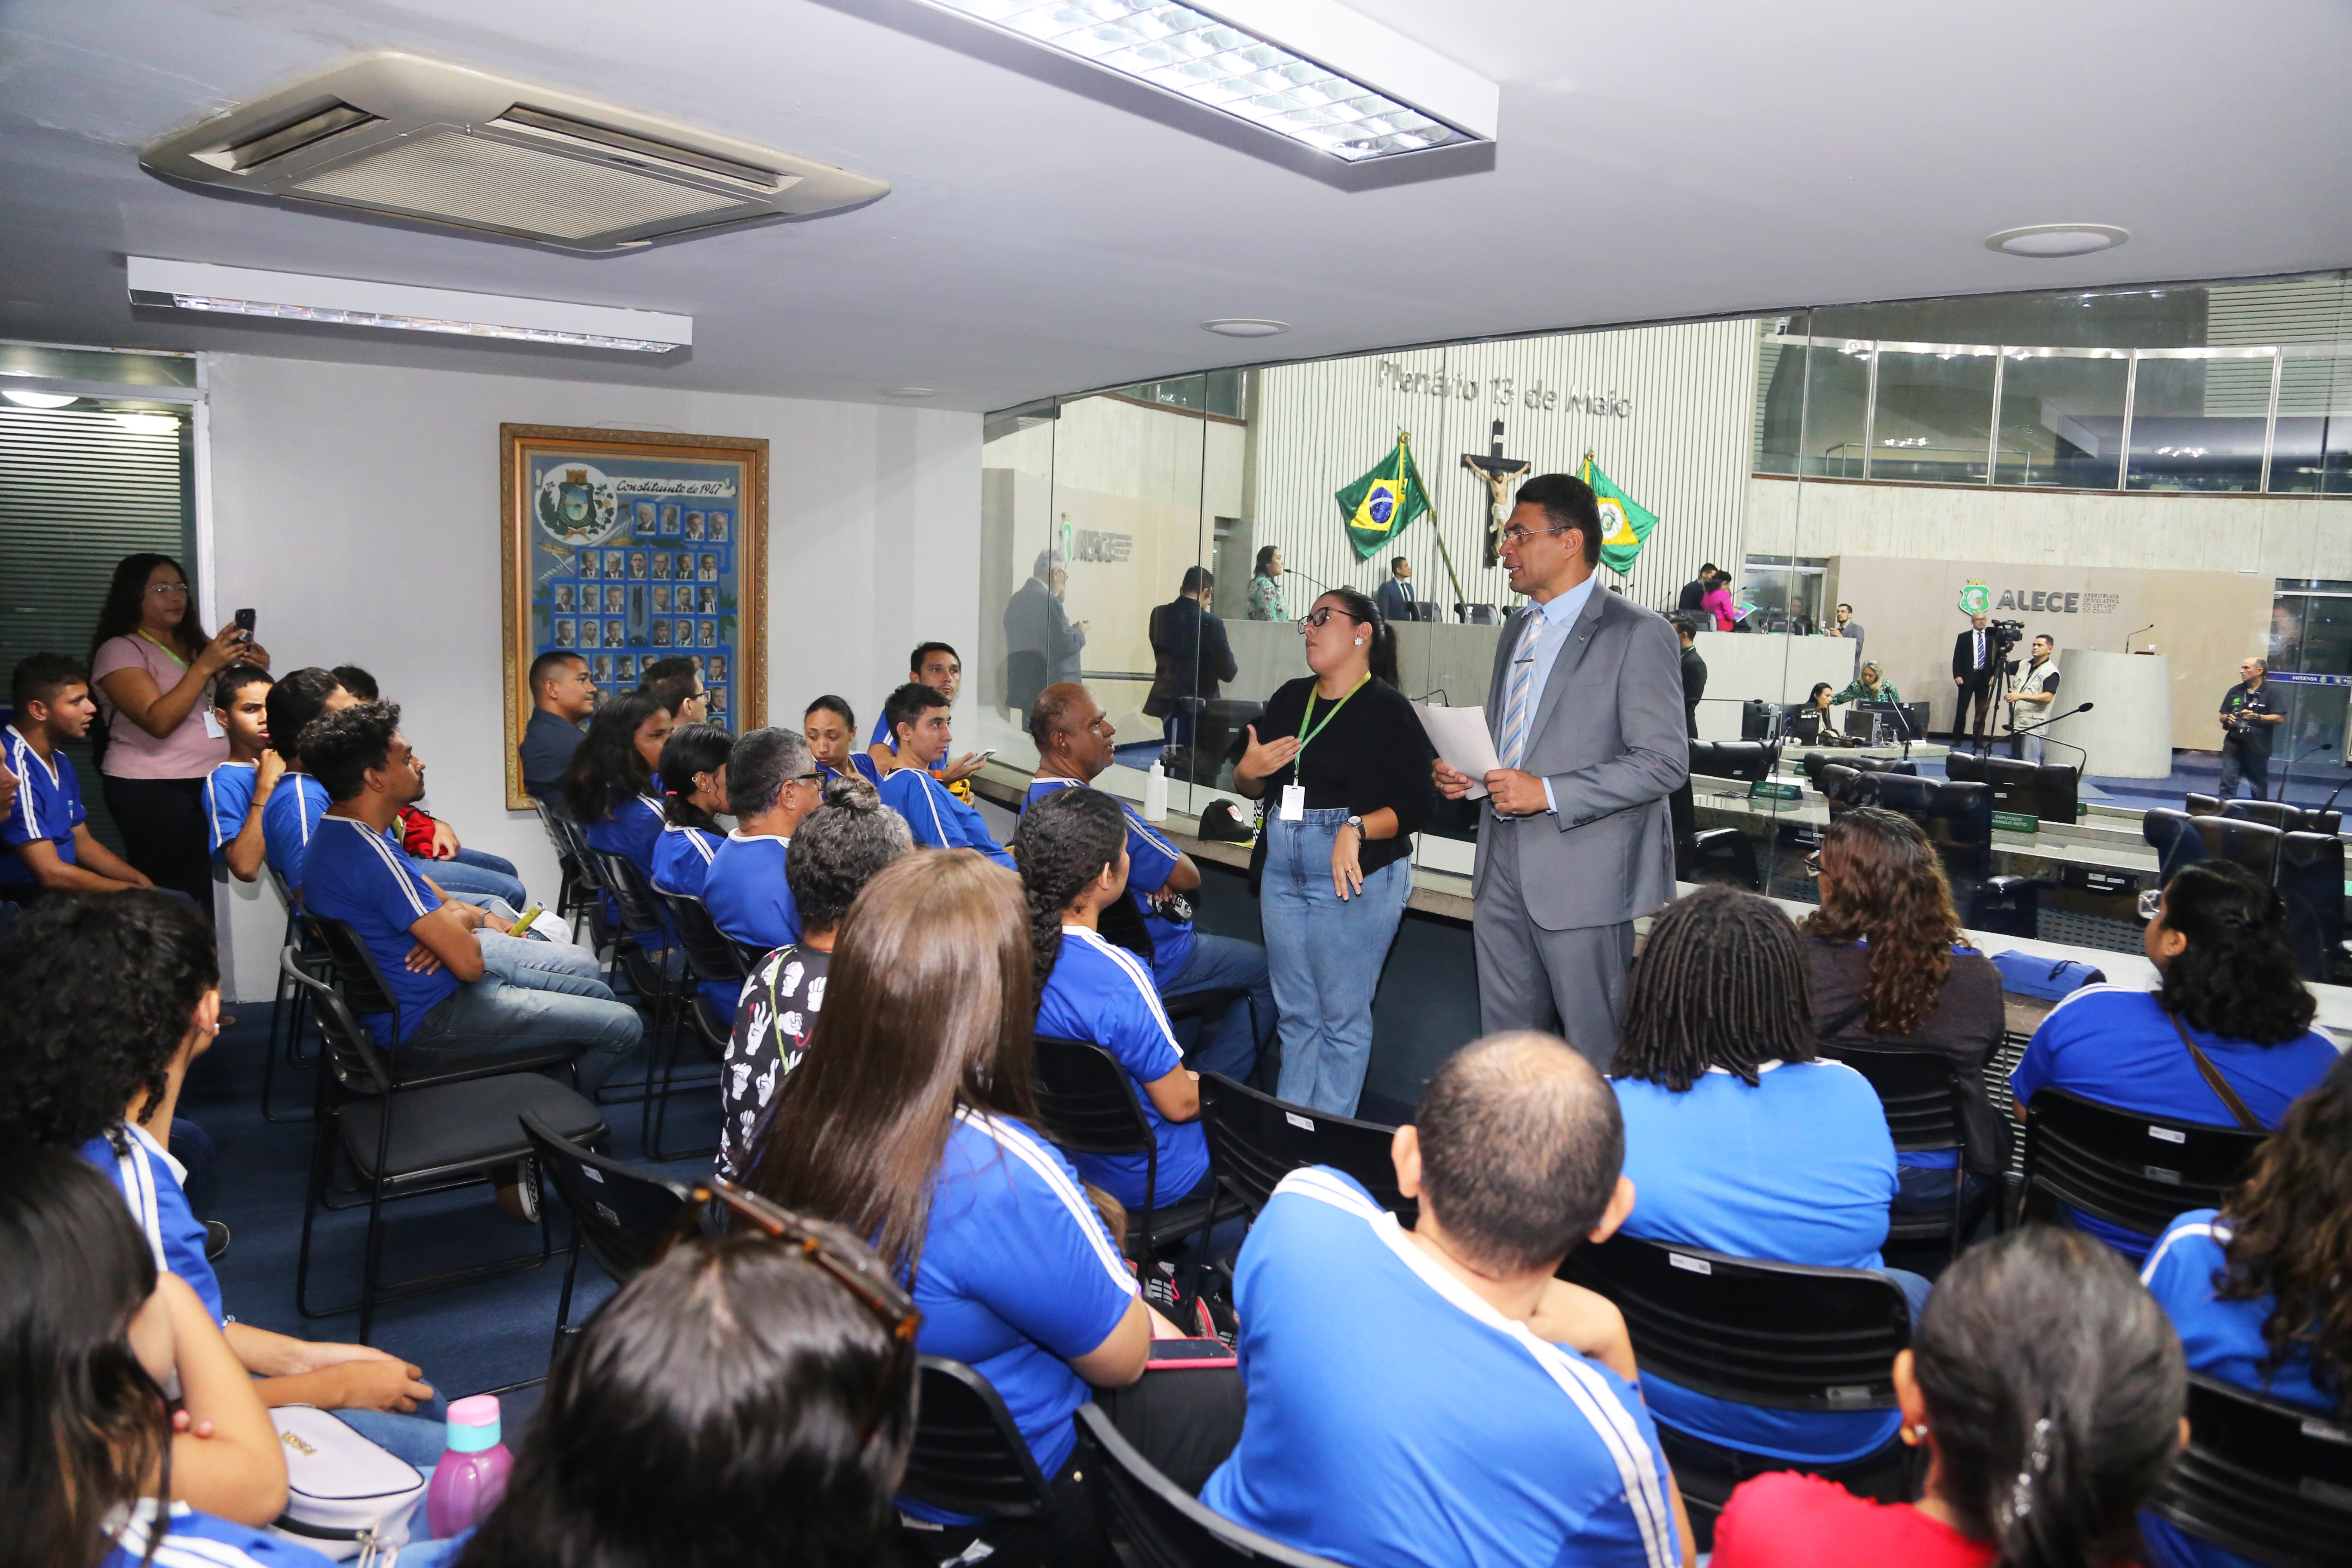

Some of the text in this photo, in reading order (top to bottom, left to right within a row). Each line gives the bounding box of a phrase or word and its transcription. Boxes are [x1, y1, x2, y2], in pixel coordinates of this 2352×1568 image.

[1378, 358, 1632, 418] Plenário 13 de Maio
[616, 480, 723, 495] Constituinte de 1947
[1996, 589, 2079, 613] ALECE
